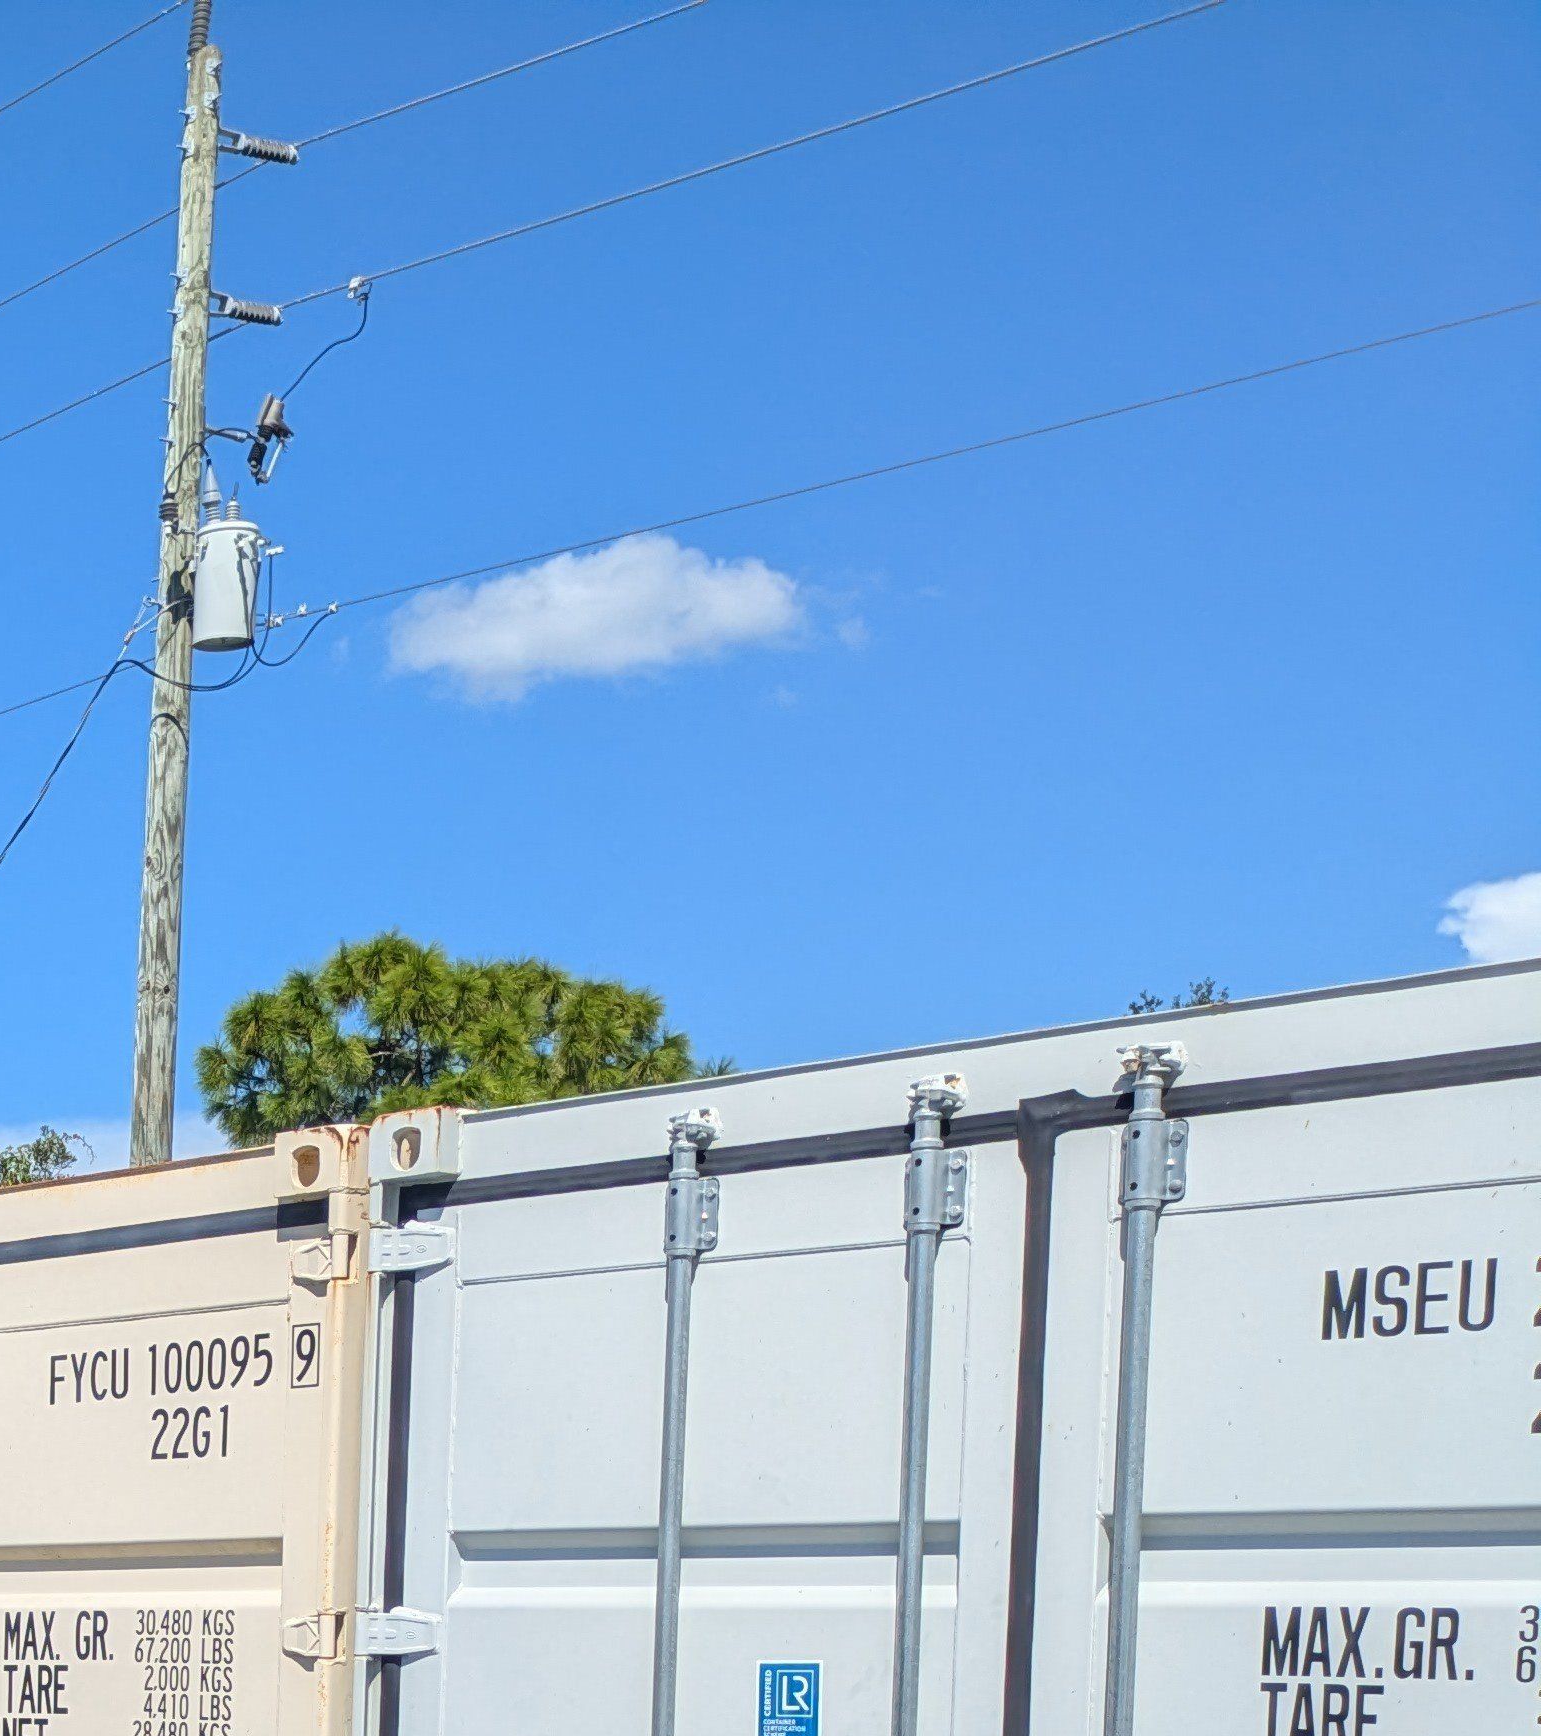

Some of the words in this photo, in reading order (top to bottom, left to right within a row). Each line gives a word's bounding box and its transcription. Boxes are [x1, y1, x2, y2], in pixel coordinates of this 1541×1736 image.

[1321, 1257, 1498, 1340] MSEU
[49, 1347, 129, 1405] FYCU
[148, 1333, 273, 1396] 100095
[295, 1328, 316, 1383] 9
[150, 1404, 229, 1460] 22G1
[3, 1610, 61, 1661] MAX.
[75, 1610, 114, 1661] GR.
[135, 1609, 192, 1636] 30,480
[202, 1609, 235, 1636] KGS
[134, 1637, 191, 1664] 67,200
[201, 1637, 234, 1665] LBS
[3, 1664, 69, 1715] TARE
[144, 1665, 190, 1692] 2,000
[200, 1665, 233, 1693] KGS
[143, 1693, 190, 1720] 4,410
[199, 1694, 232, 1721] LBS
[782, 1675, 809, 1711] LR
